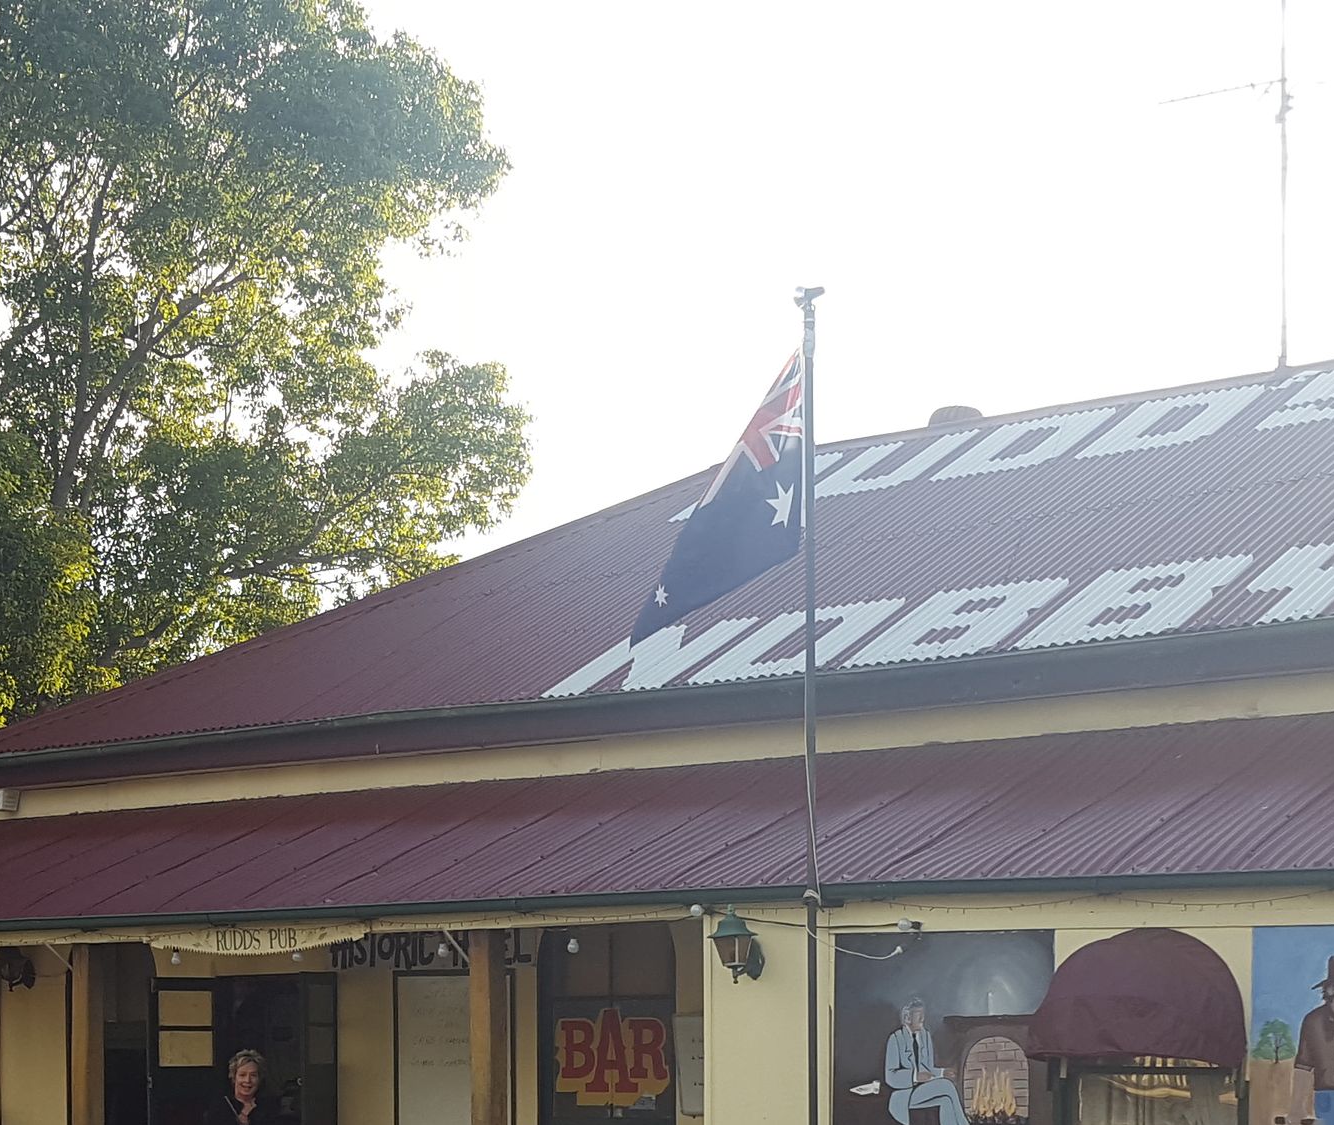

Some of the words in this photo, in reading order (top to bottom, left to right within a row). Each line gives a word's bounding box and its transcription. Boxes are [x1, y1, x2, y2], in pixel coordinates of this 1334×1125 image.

[268, 928, 297, 949] PUB
[330, 931, 435, 969] HISTORIC
[561, 1009, 668, 1092] BAR
